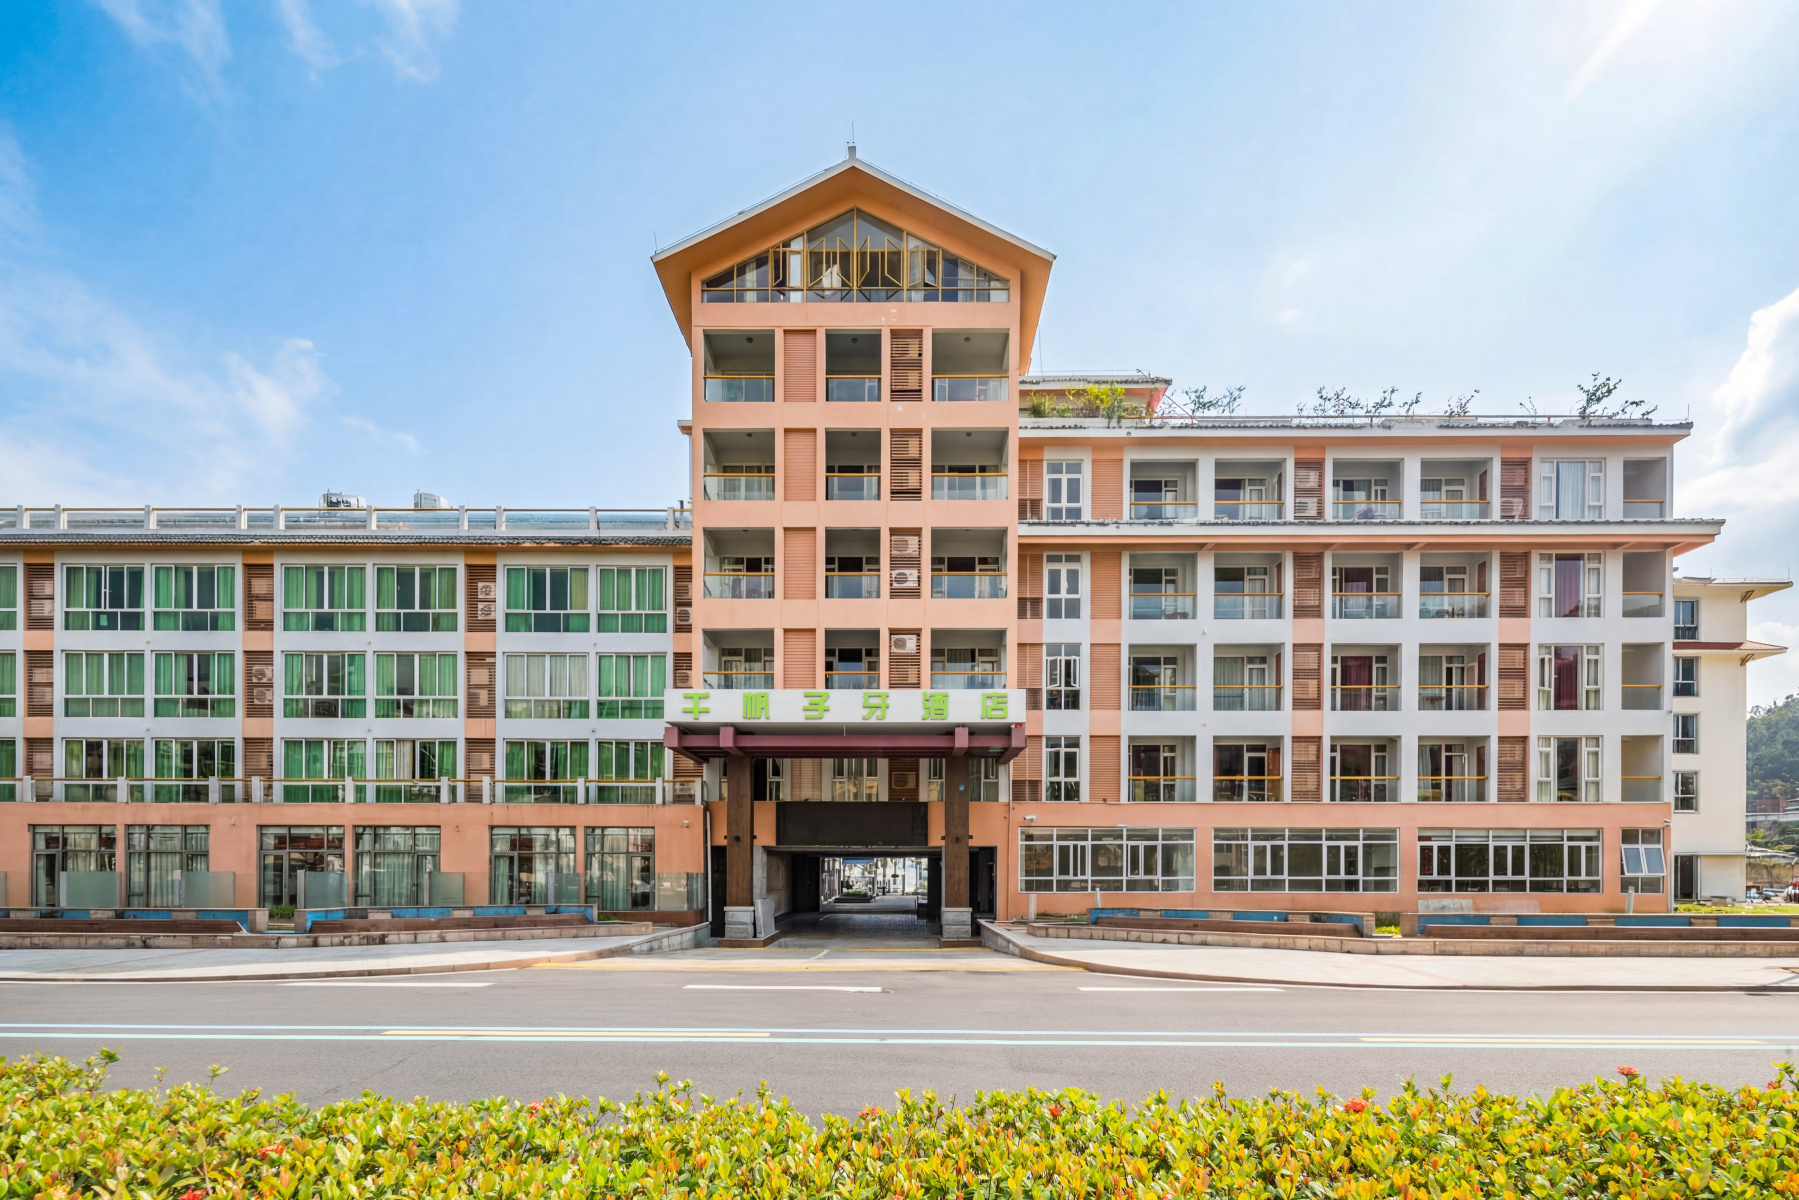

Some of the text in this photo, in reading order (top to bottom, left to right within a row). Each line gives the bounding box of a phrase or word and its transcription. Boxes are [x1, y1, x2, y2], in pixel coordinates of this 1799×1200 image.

[682, 691, 1008, 720] 千帆子牙酒店
